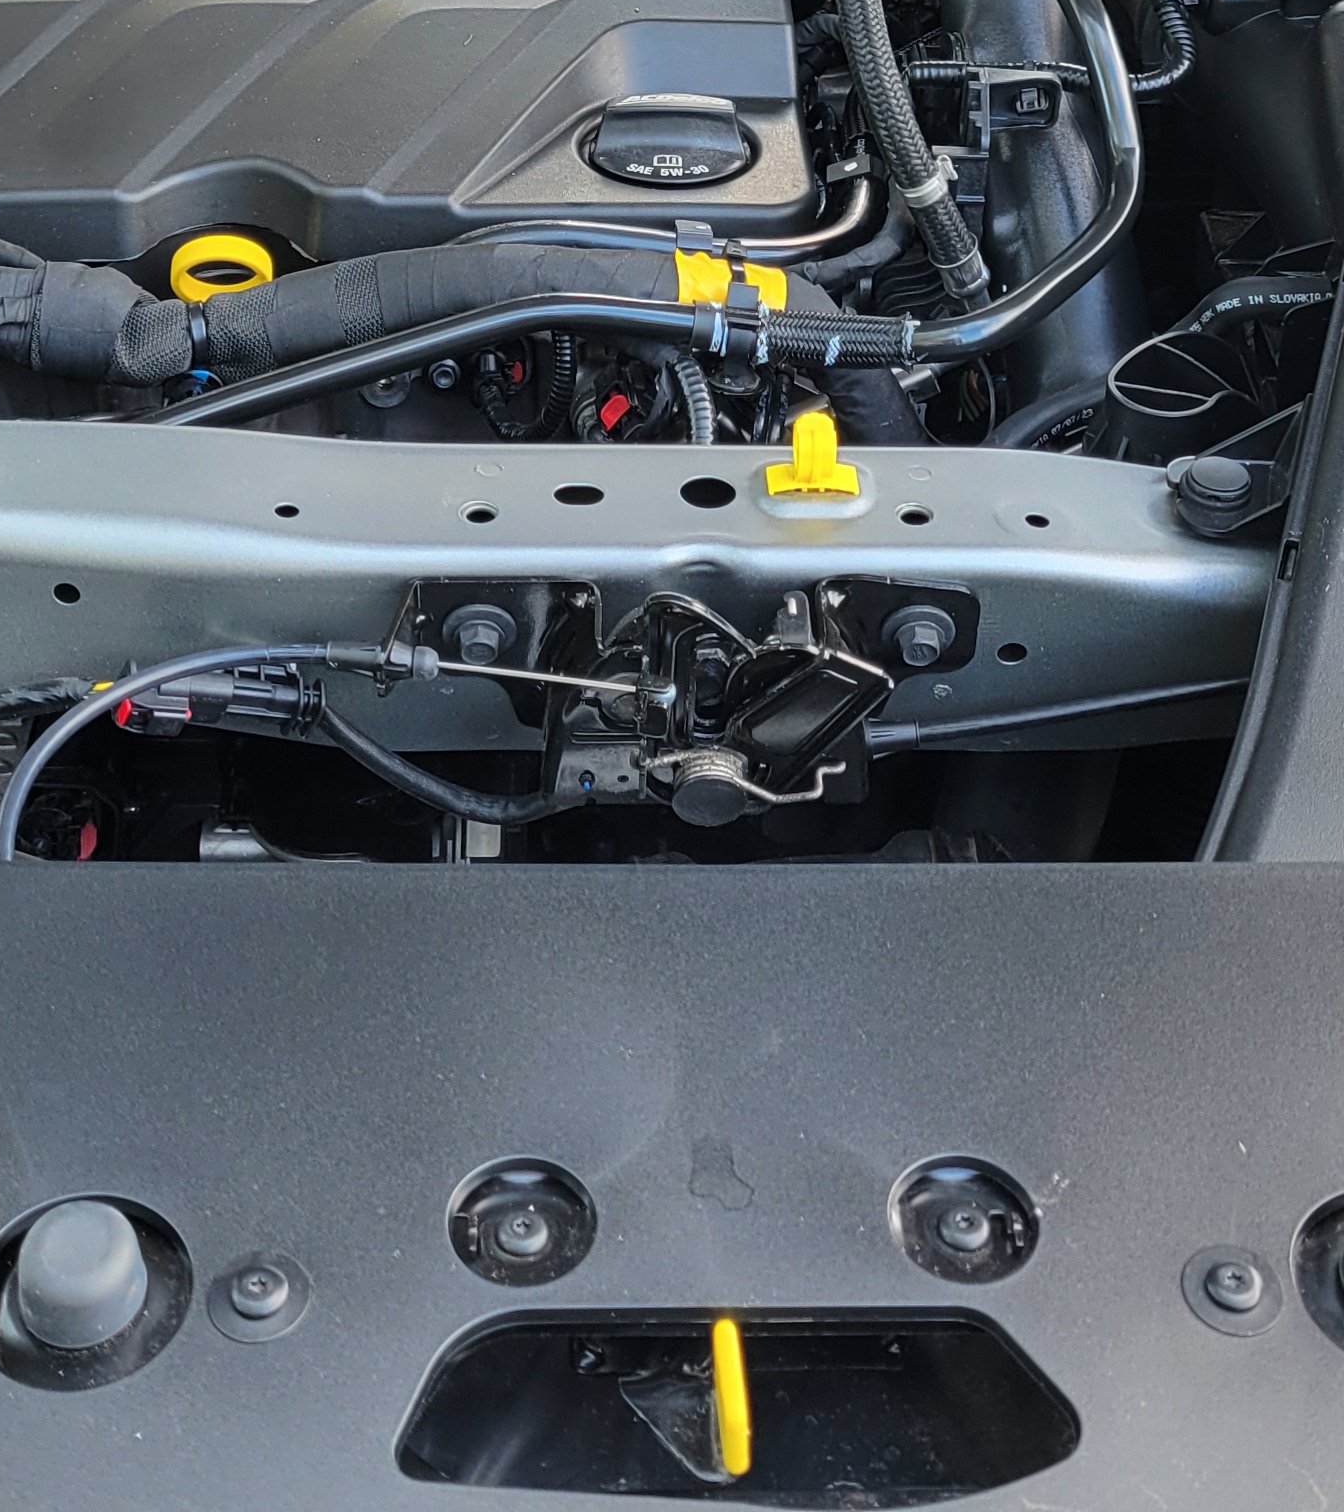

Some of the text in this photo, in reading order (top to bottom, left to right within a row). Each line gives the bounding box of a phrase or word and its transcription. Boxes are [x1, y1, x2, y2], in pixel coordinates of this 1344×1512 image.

[625, 163, 710, 177] SAE 5W-30
[1214, 297, 1243, 314] MADE
[1247, 294, 1264, 305] IN
[1269, 292, 1322, 304] SLOVAKIA
